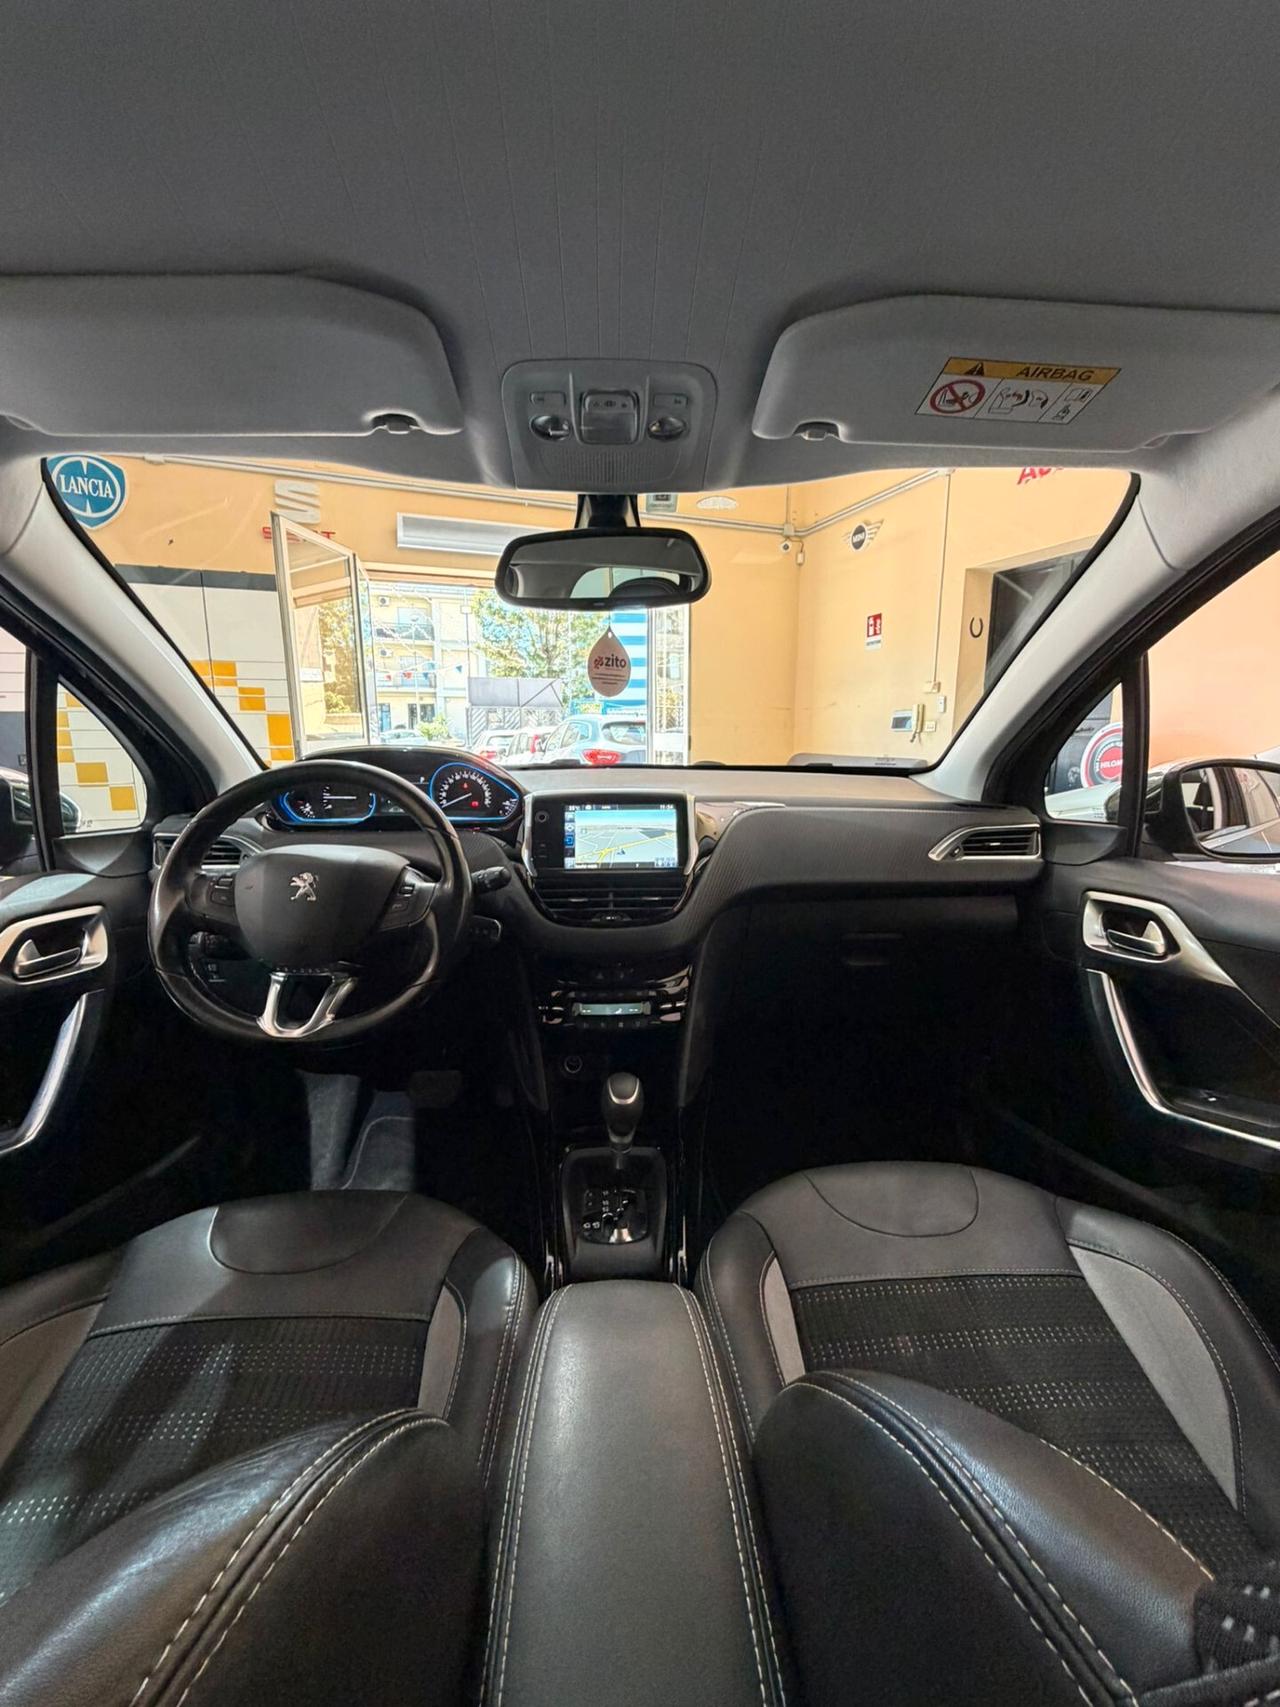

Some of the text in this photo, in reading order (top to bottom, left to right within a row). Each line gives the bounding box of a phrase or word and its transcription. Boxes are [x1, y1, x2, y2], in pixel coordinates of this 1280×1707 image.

[1016, 366, 1095, 381] AIRBAG
[59, 474, 114, 499] LANCIA
[604, 653, 627, 668] zito
